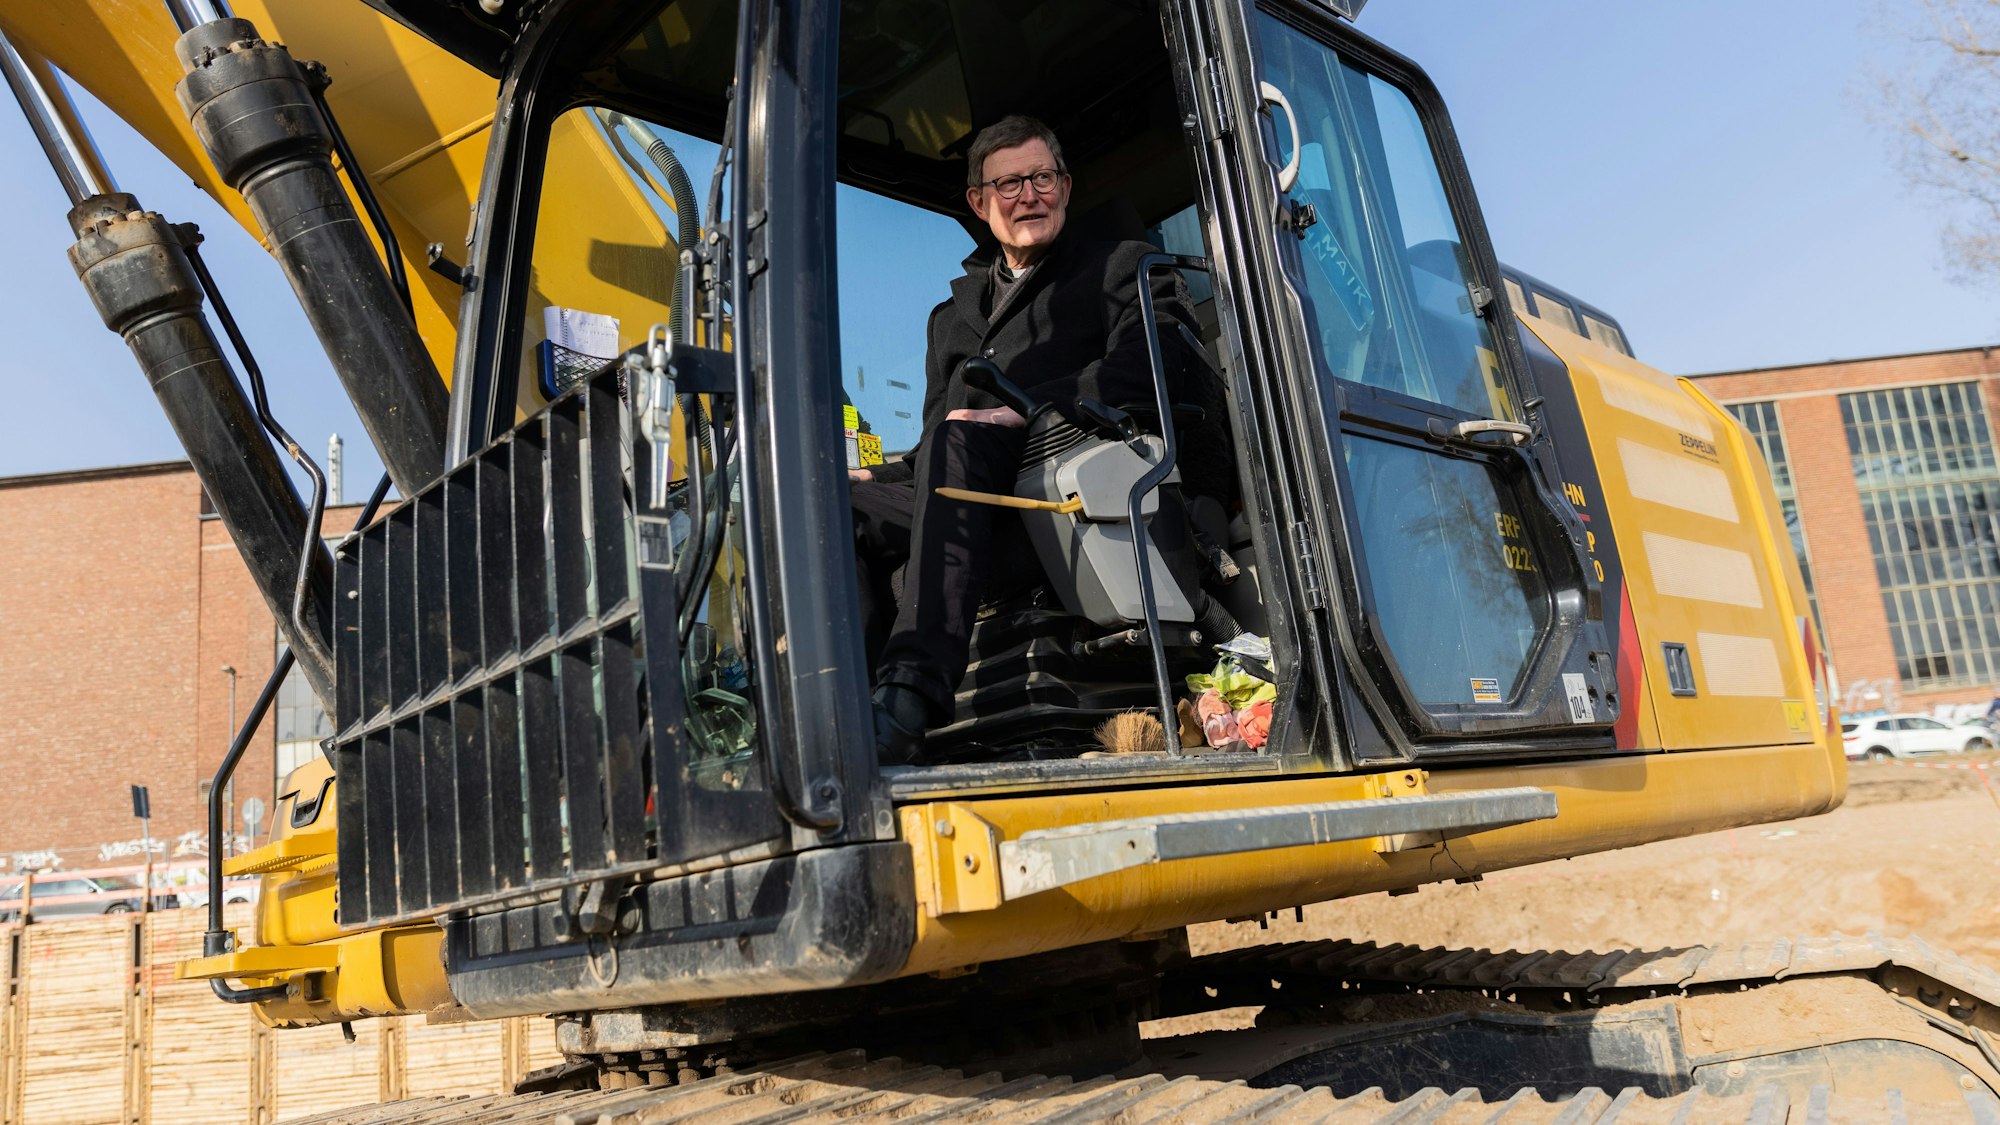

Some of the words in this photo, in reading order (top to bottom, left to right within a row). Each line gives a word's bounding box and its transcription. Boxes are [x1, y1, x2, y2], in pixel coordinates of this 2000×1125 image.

[1322, 233, 1367, 305] MAIK
[1678, 432, 1717, 457] ZEPPELIN
[1503, 545, 1538, 573] 022
[1570, 696, 1588, 719] 104
